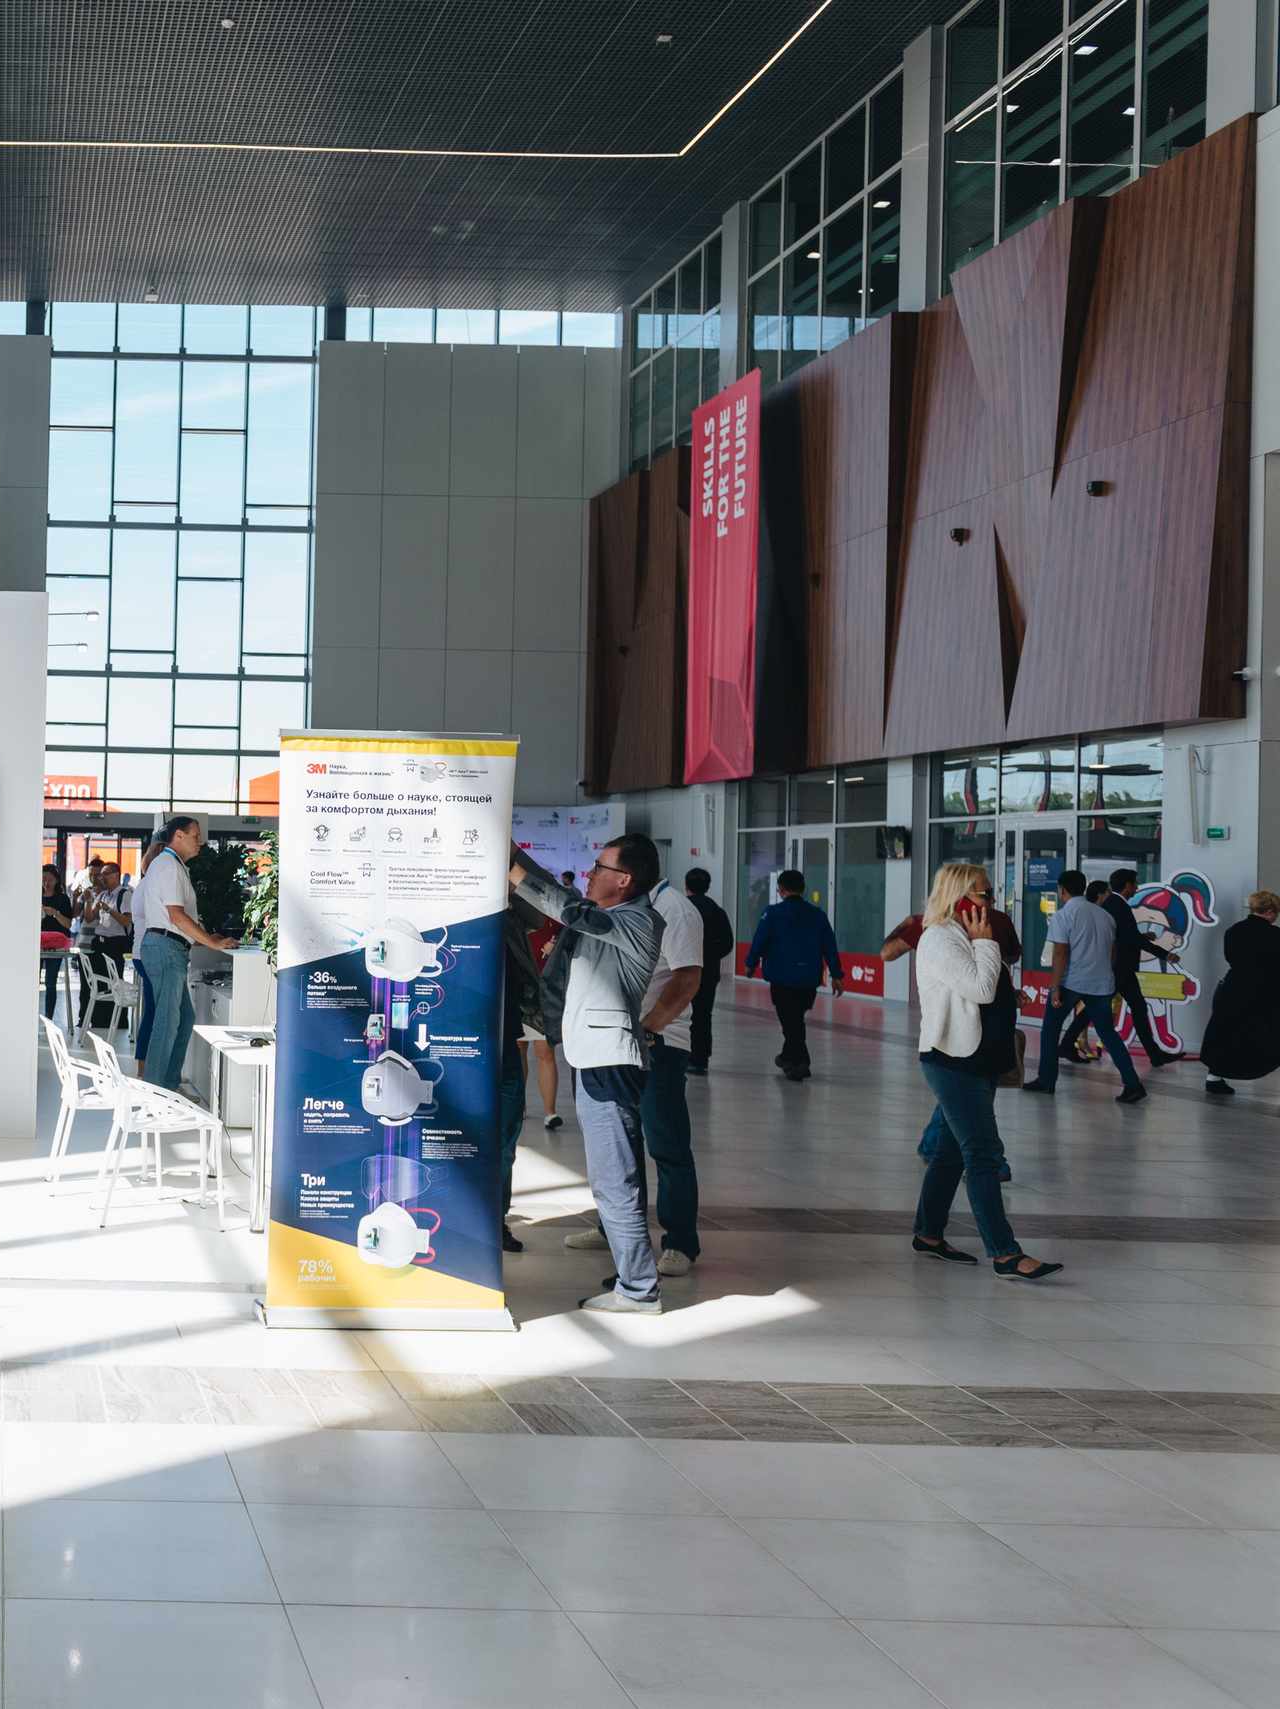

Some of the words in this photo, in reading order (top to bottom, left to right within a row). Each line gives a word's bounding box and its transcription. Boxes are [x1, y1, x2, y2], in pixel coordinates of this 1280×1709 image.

[718, 405, 731, 470] THE
[733, 395, 748, 519] FUTURE
[702, 416, 716, 518] SKILLS
[716, 472, 730, 538] FOR
[306, 763, 327, 775] 3M
[306, 789, 350, 799] Узнайте
[353, 790, 395, 801] больше
[397, 793, 405, 801] о
[407, 793, 442, 804] науке,
[445, 793, 492, 805] стоящей
[305, 805, 318, 813] за
[321, 804, 384, 816] комфортом
[386, 806, 437, 817] дыхания!
[429, 1034, 463, 1042] Температура
[302, 1097, 345, 1111] Легче
[421, 1127, 463, 1135] Совместимость
[300, 1173, 326, 1189] Три
[298, 1259, 334, 1274] 78%
[297, 1273, 337, 1283] рабочих
